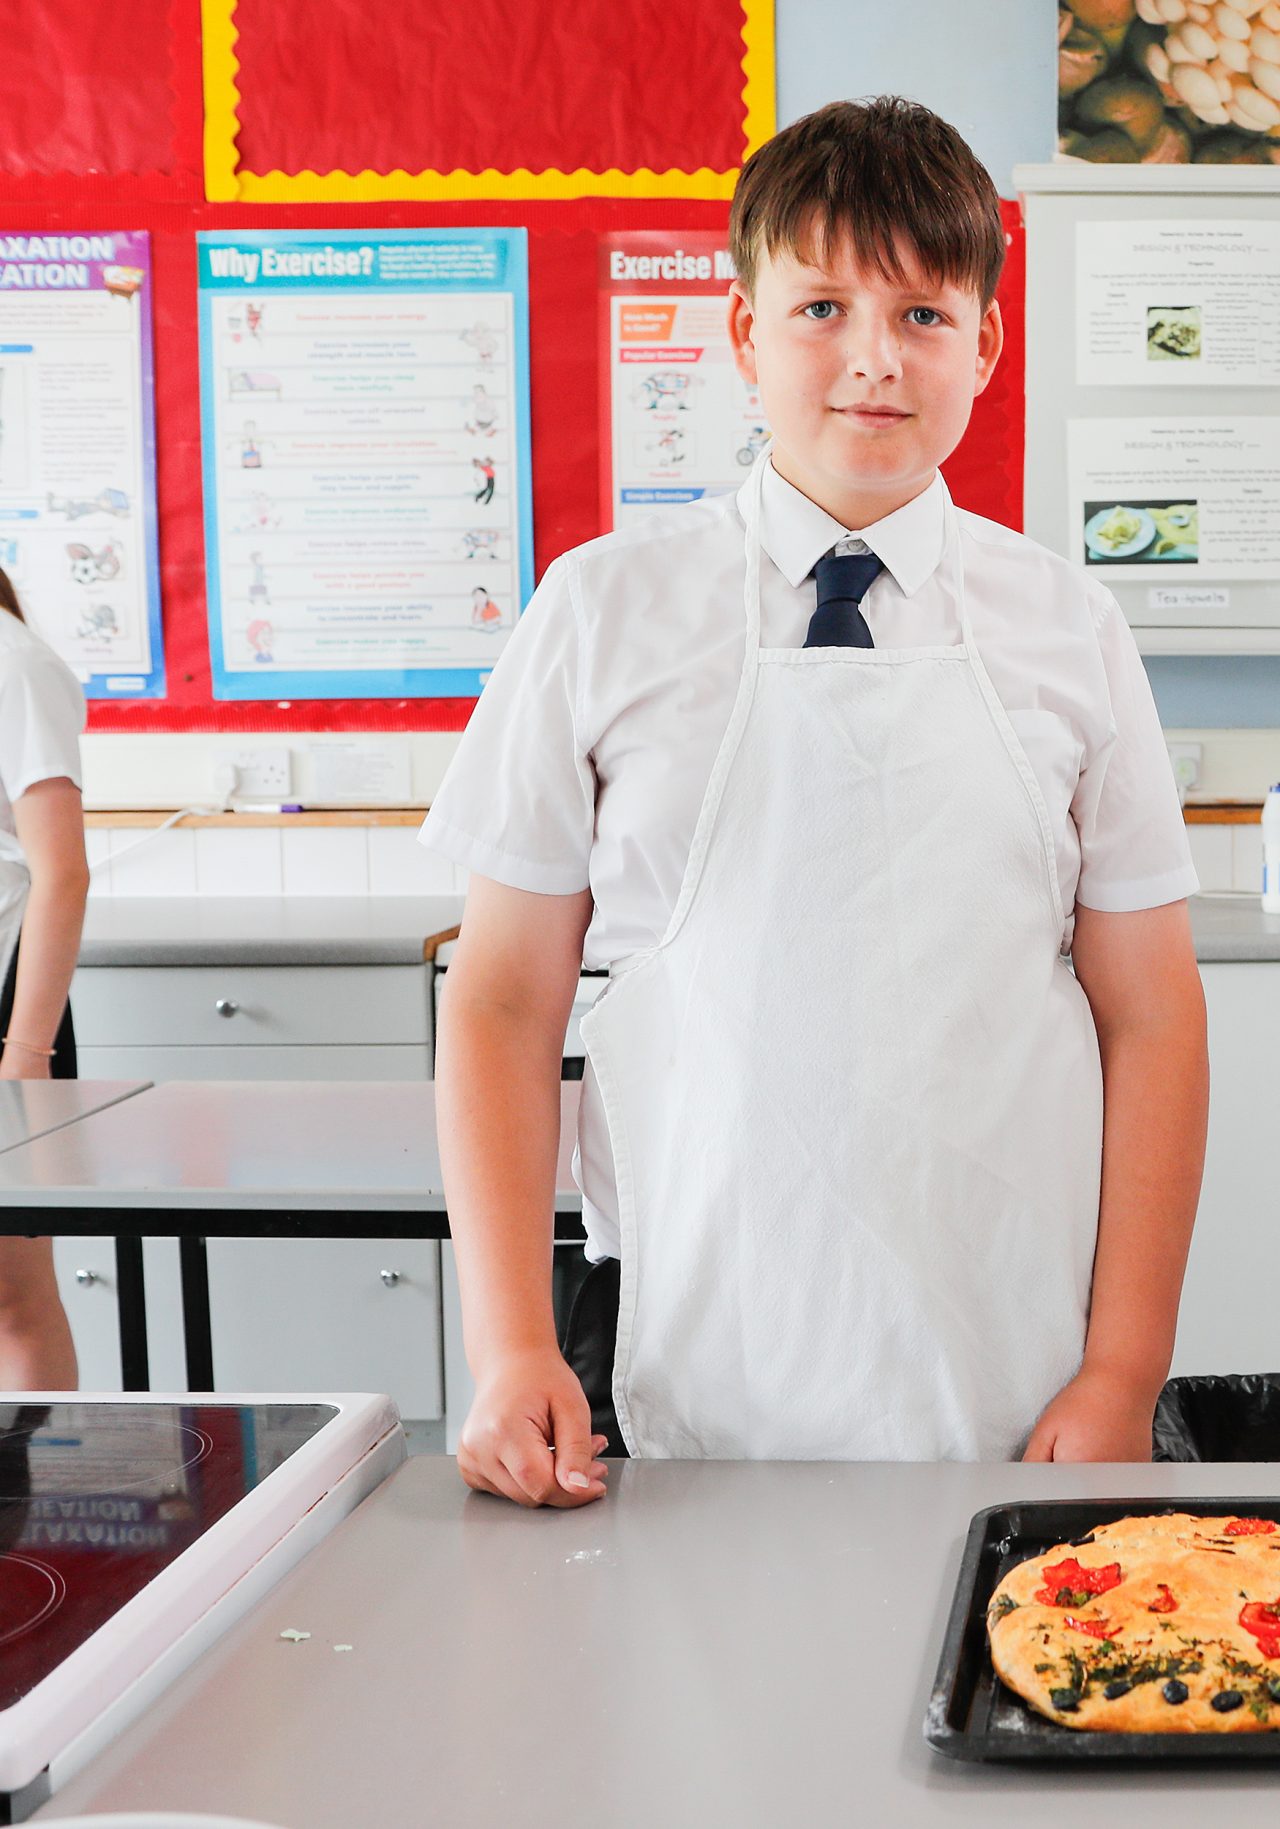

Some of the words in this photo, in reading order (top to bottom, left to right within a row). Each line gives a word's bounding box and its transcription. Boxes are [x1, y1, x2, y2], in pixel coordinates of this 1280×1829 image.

[0, 263, 89, 288] ATION
[208, 247, 260, 283] Why
[261, 246, 374, 276] Exercise?
[610, 250, 711, 280] Exercise
